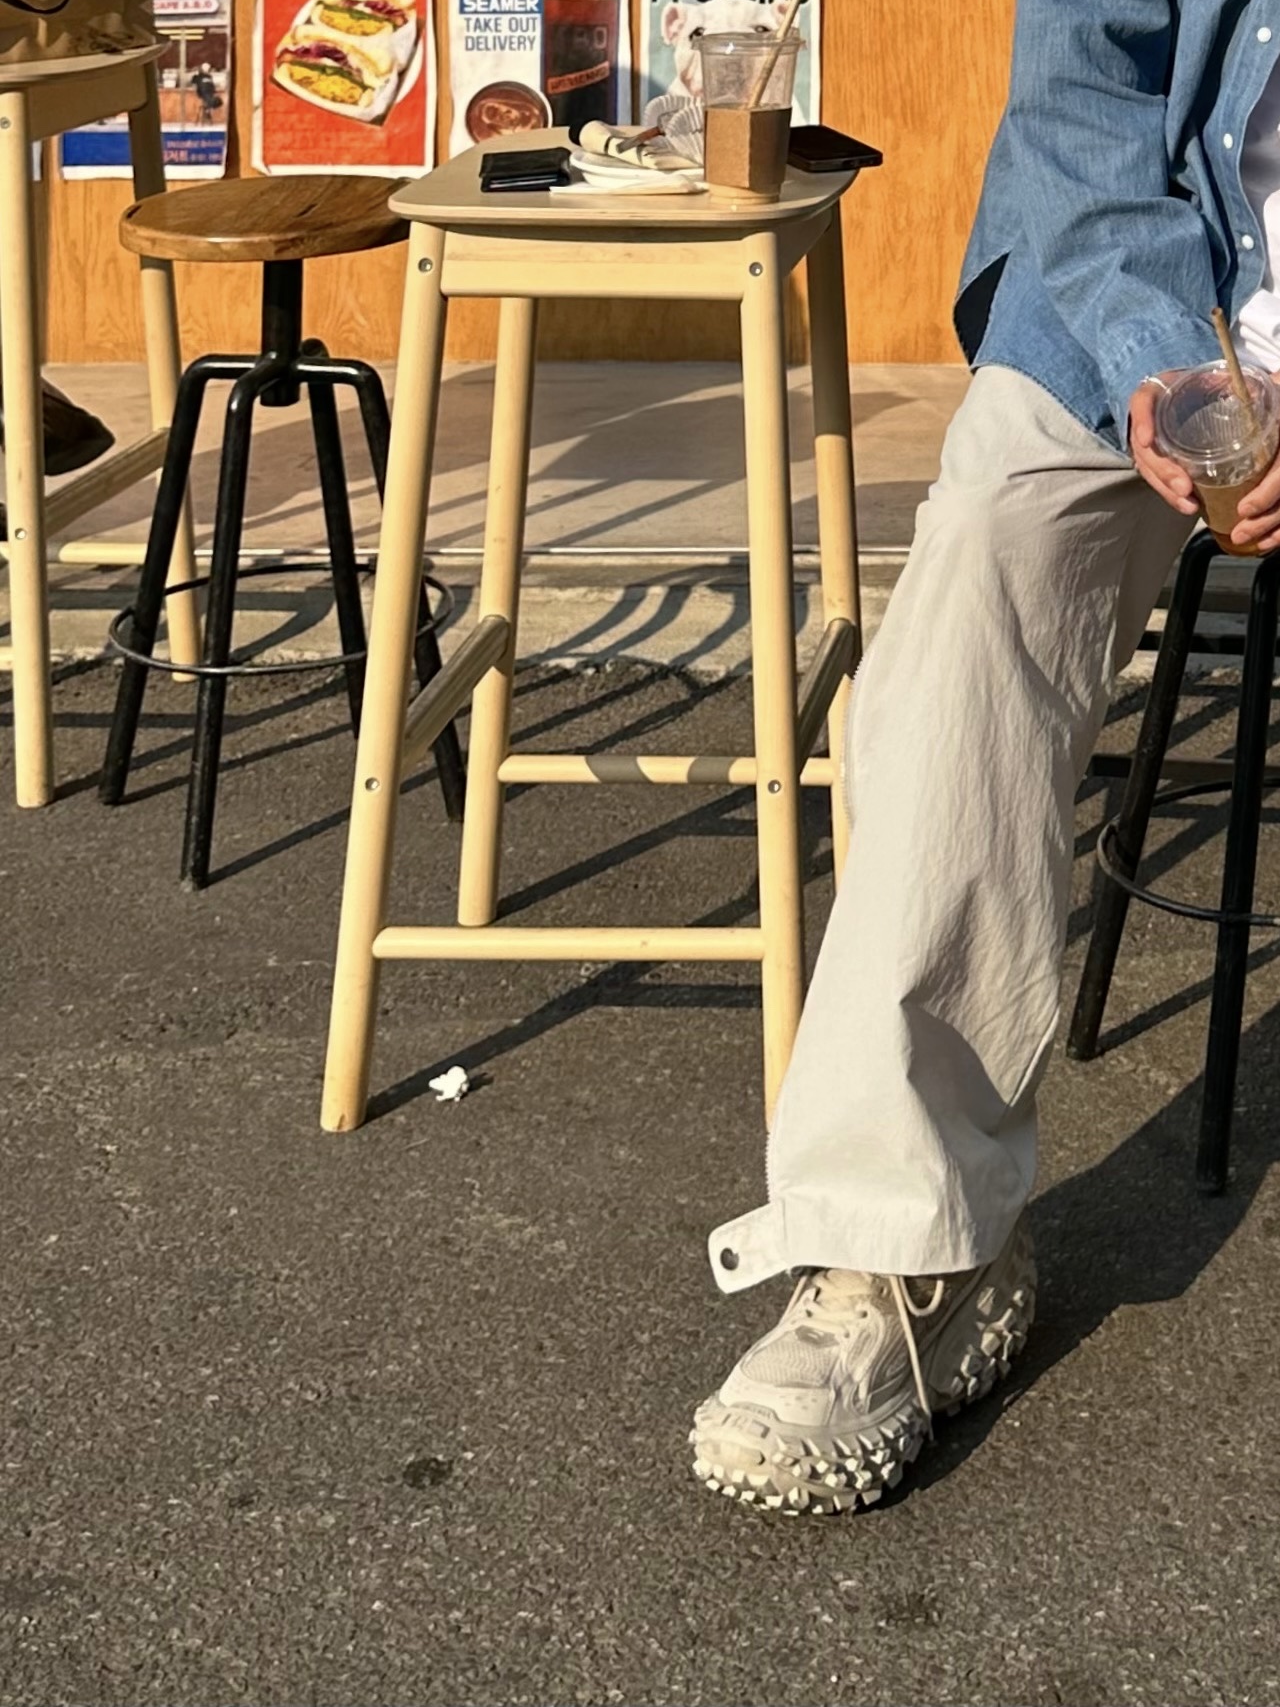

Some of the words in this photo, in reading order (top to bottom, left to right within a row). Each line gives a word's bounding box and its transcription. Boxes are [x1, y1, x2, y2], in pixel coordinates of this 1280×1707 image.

[464, 16, 503, 33] TAKE
[508, 16, 538, 33] OUT
[464, 35, 536, 52] DELIVERY
